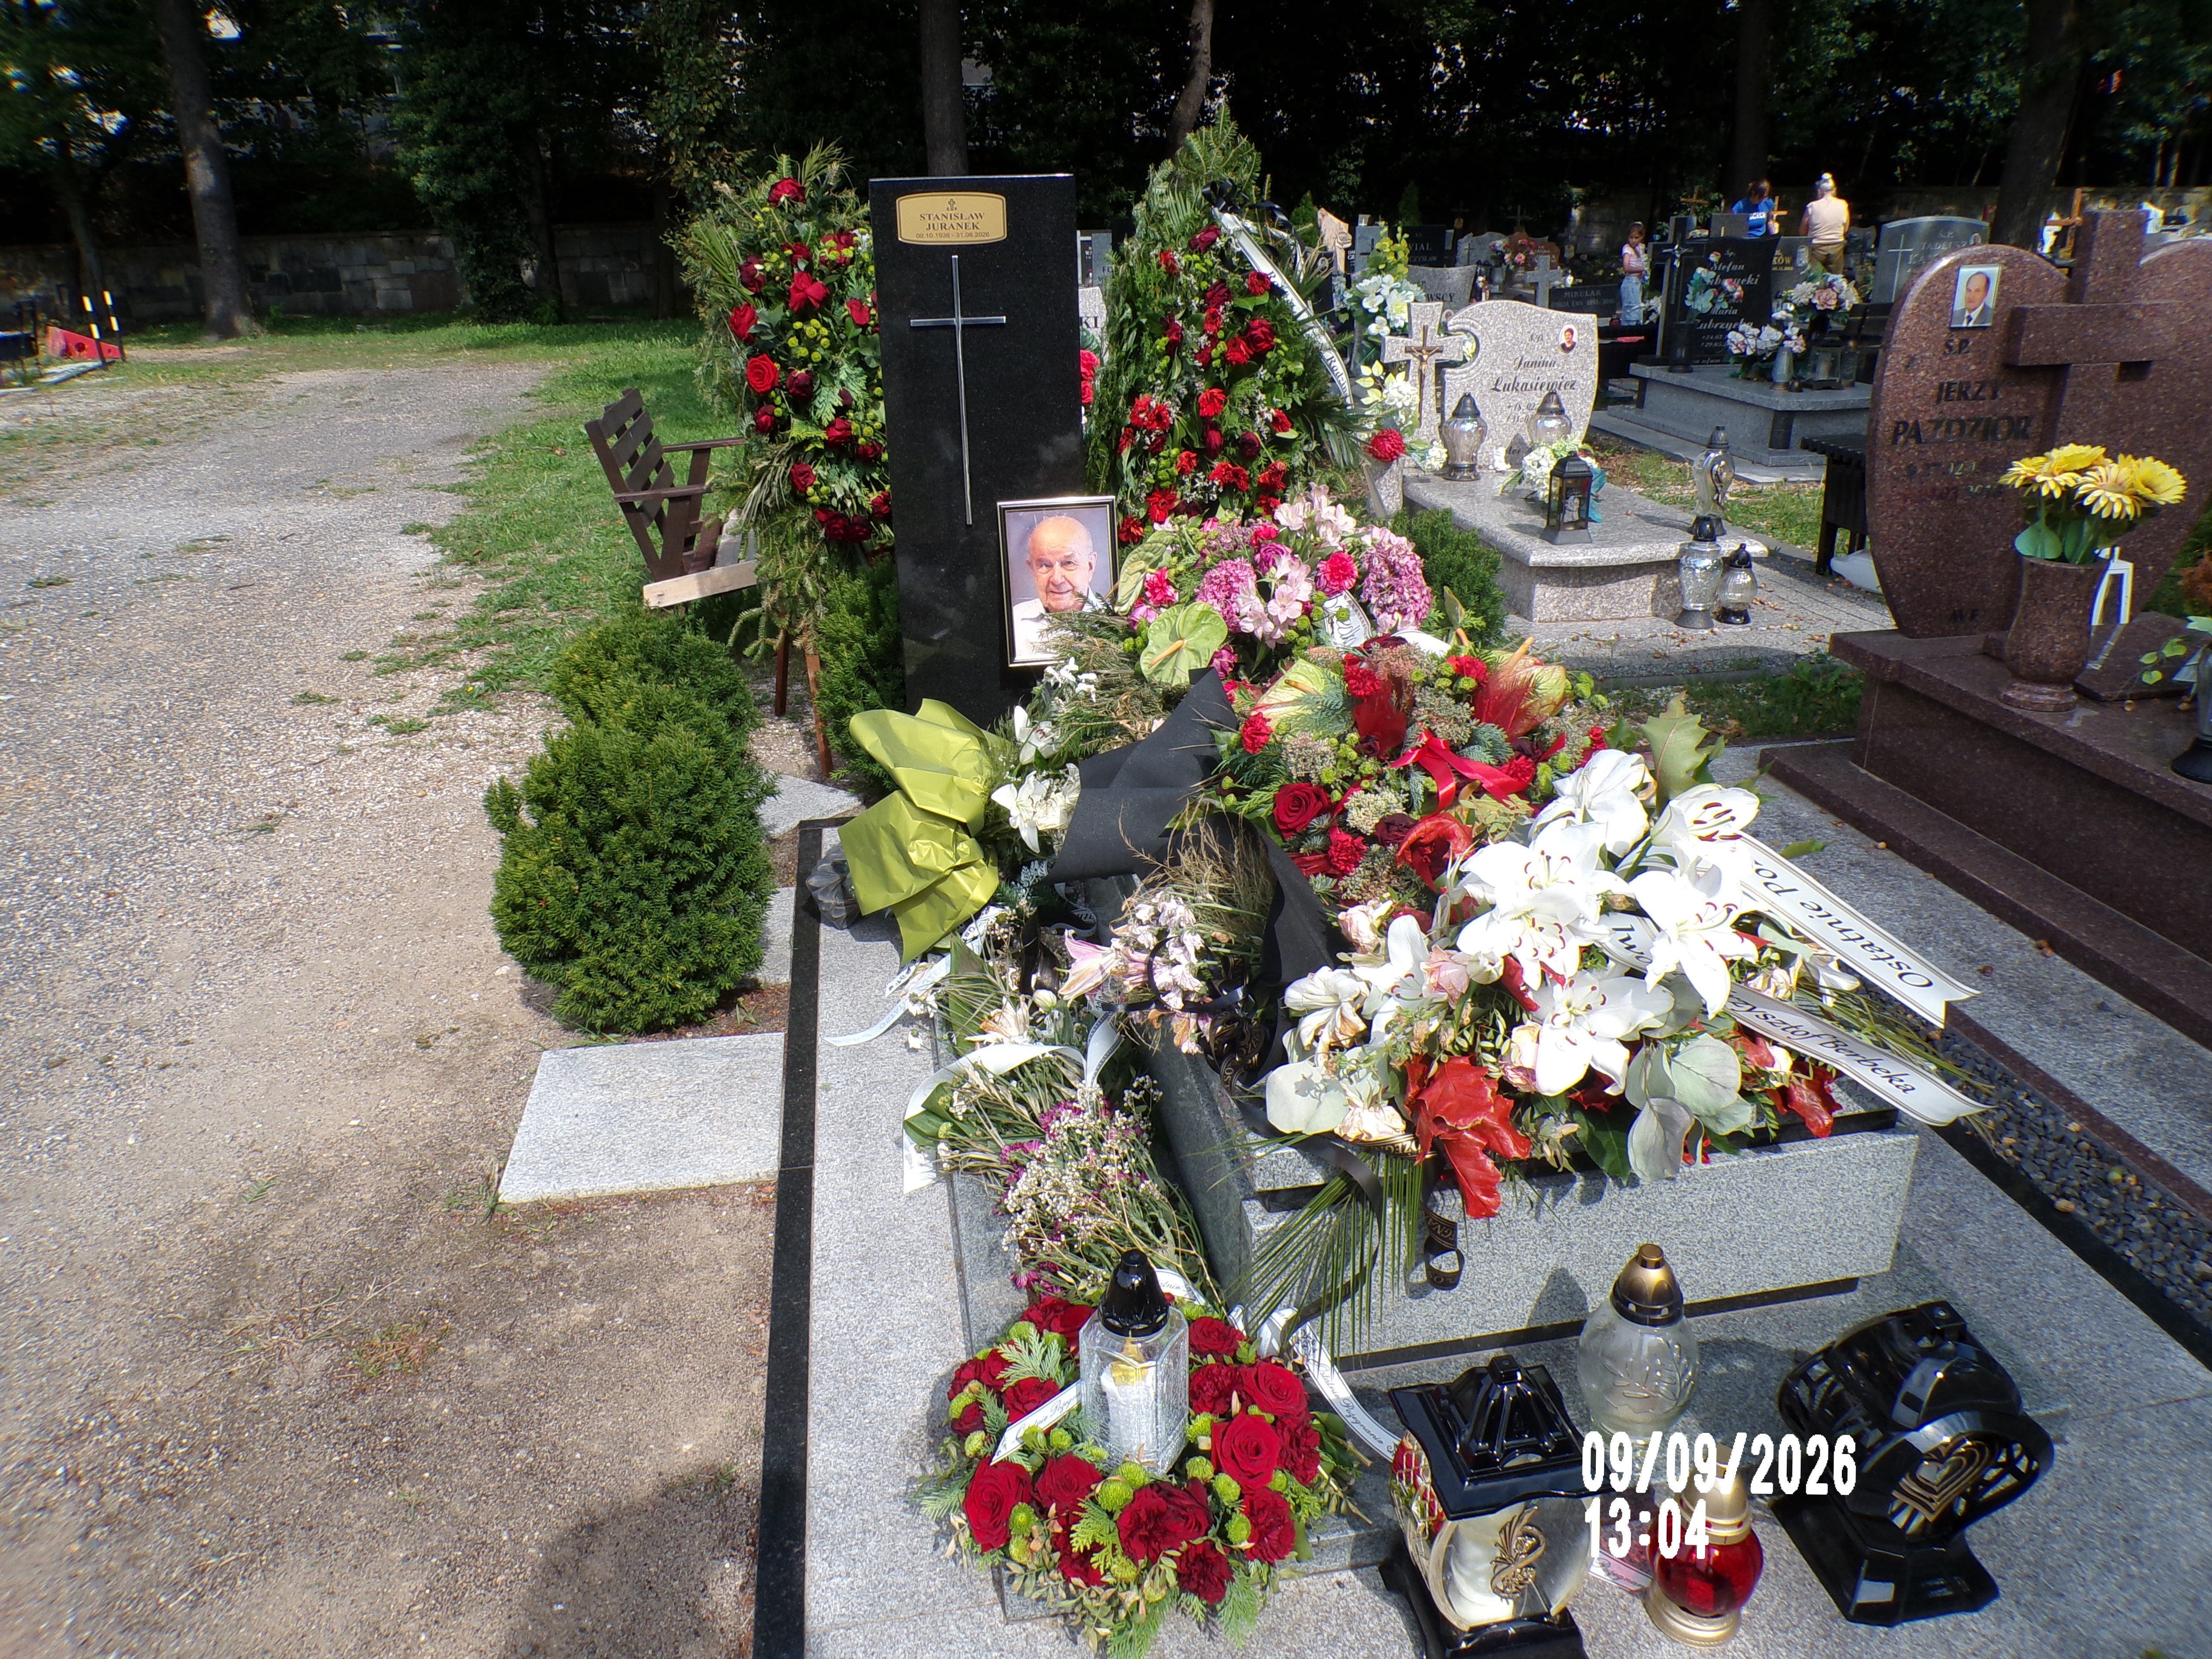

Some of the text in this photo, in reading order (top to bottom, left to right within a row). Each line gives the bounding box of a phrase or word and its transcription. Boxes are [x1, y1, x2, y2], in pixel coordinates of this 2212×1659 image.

[926, 222, 980, 231] JURANEK
[1710, 261, 1745, 272] Stefan
[1426, 292, 1455, 302] WSCY
[1080, 317, 1099, 329] KI
[1514, 355, 1556, 371] Janina
[1933, 381, 1999, 407] JERZY
[1754, 860, 1934, 989] Ostatnie Po
[1819, 1039, 1917, 1095] Berbeka
